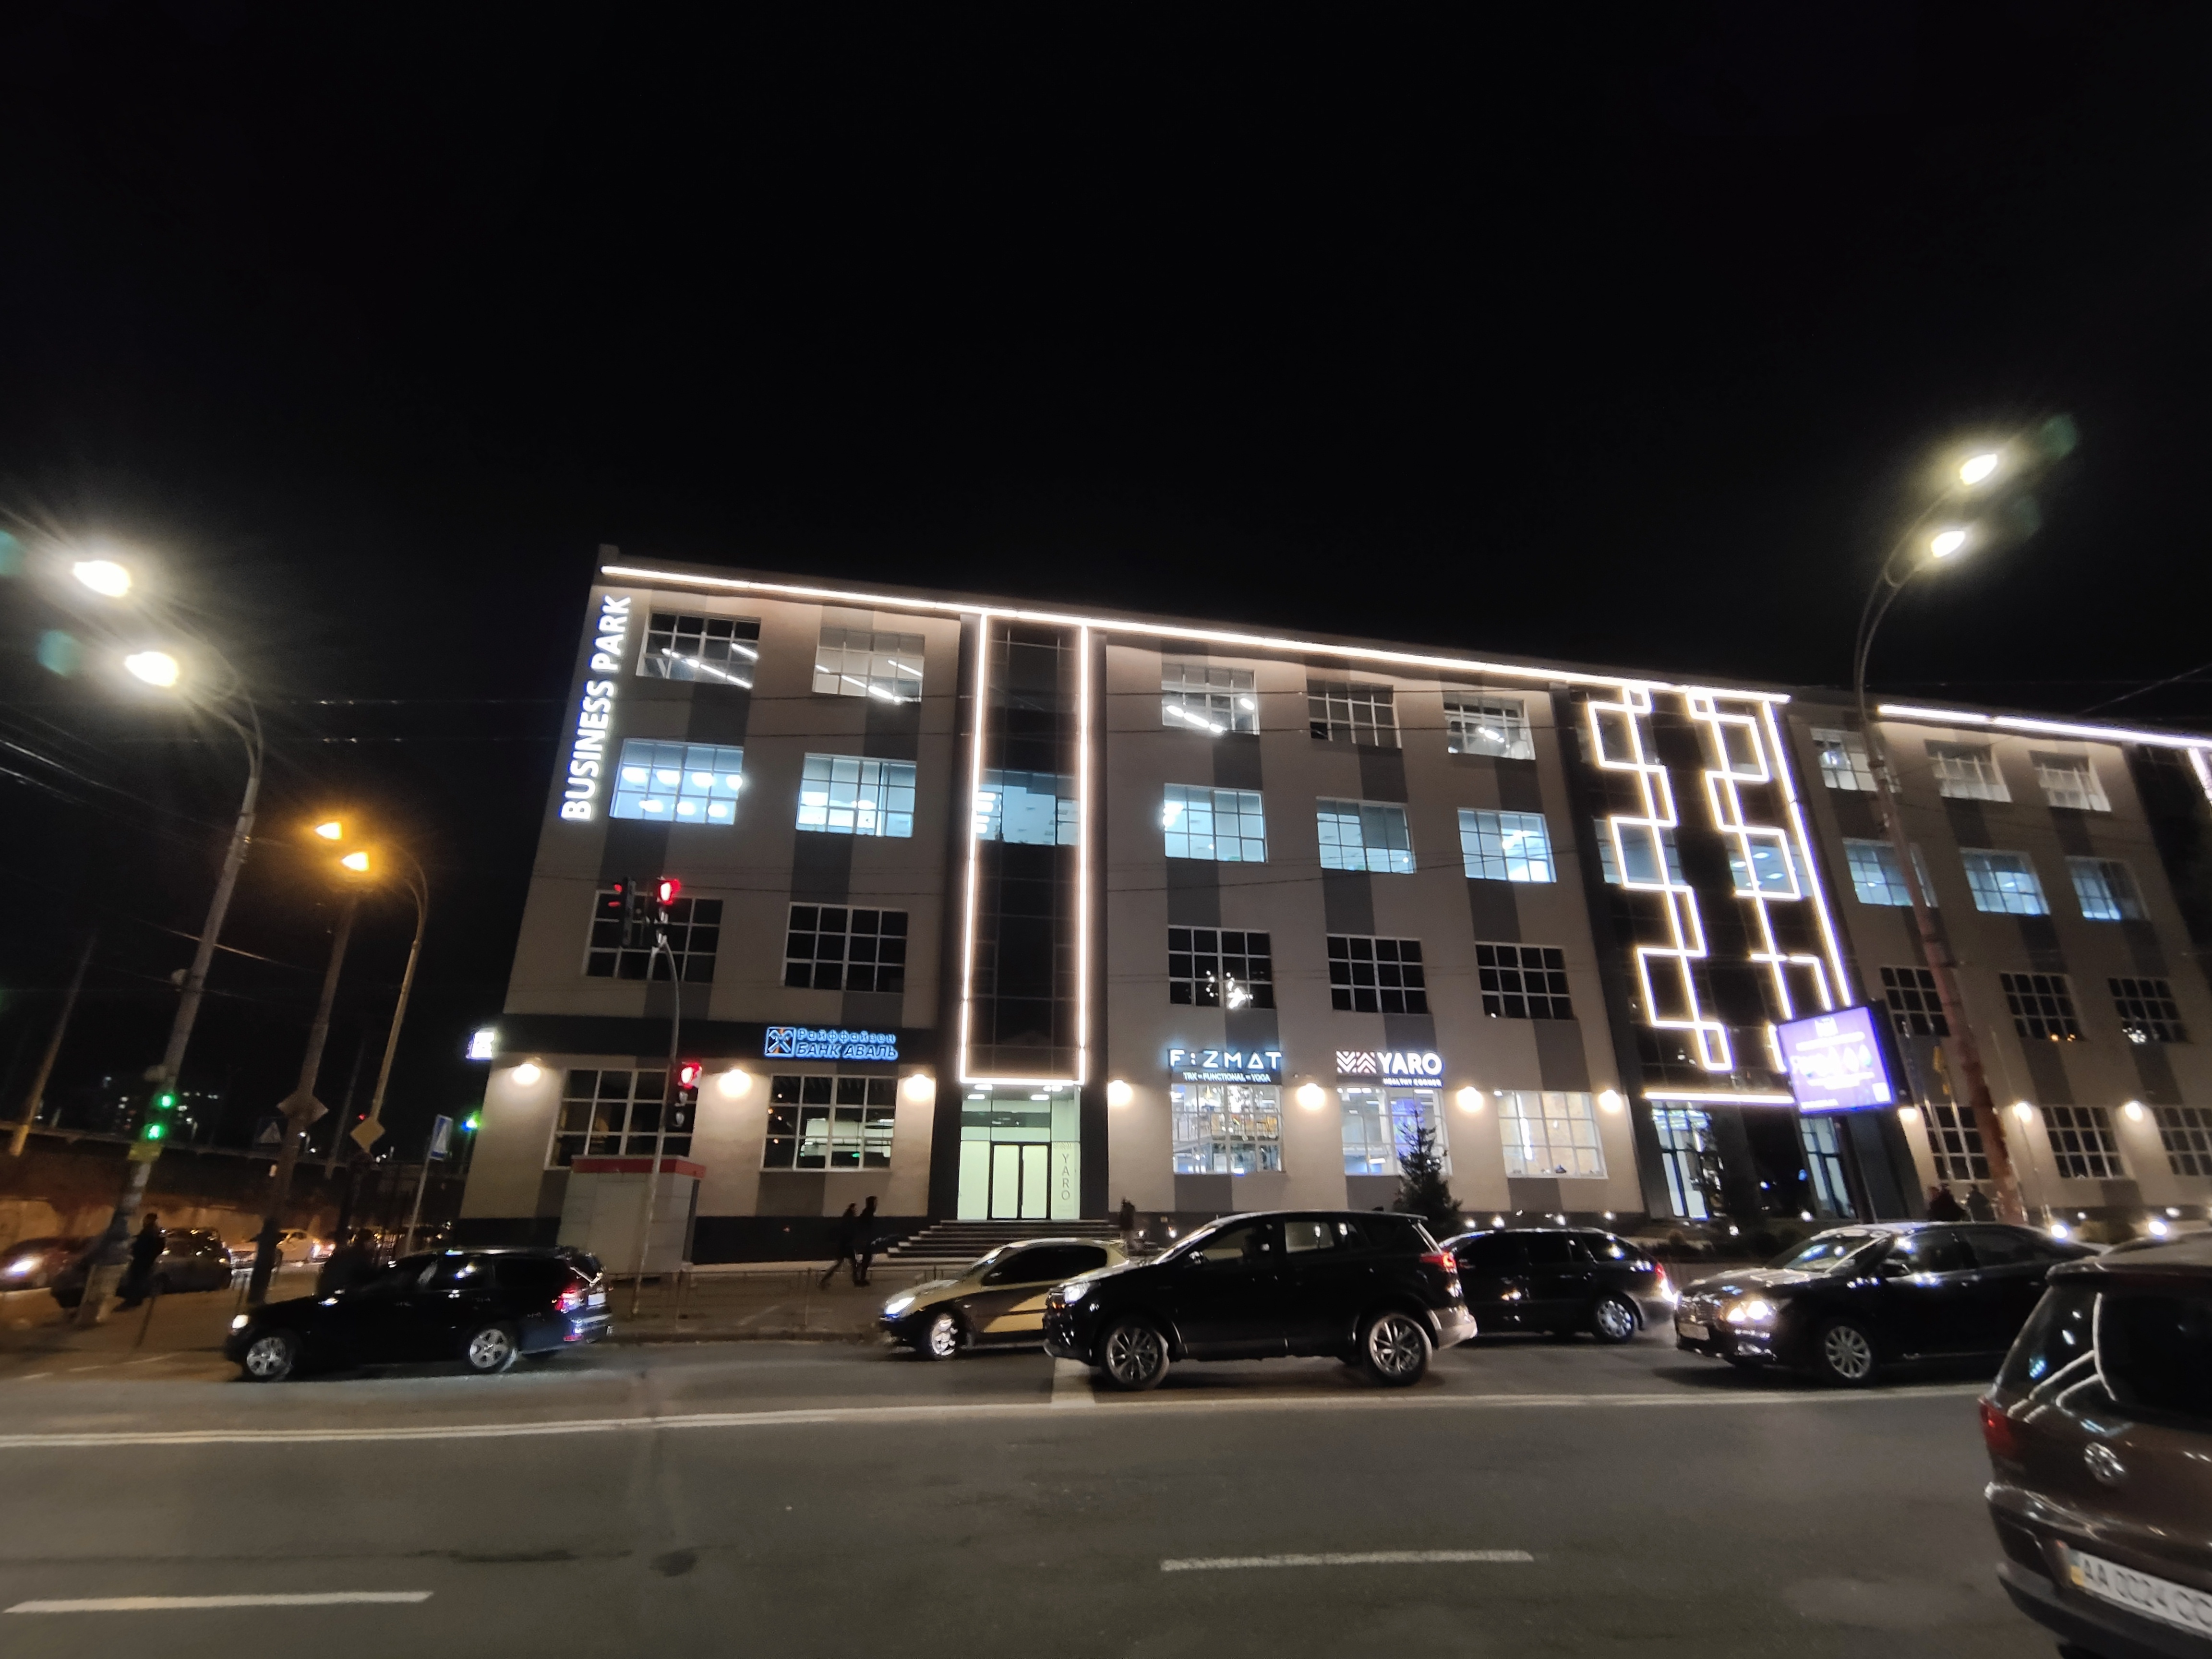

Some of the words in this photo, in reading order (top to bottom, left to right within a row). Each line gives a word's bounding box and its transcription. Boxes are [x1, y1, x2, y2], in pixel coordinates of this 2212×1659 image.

[560, 679, 615, 821] BUSINESS
[590, 594, 632, 672] PARK
[797, 1028, 897, 1044] Райффайзен
[795, 1042, 842, 1058] БАНК
[842, 1045, 899, 1060] АВАЛЬ
[1377, 1052, 1443, 1075] YARO
[1061, 1153, 1070, 1201] YARO
